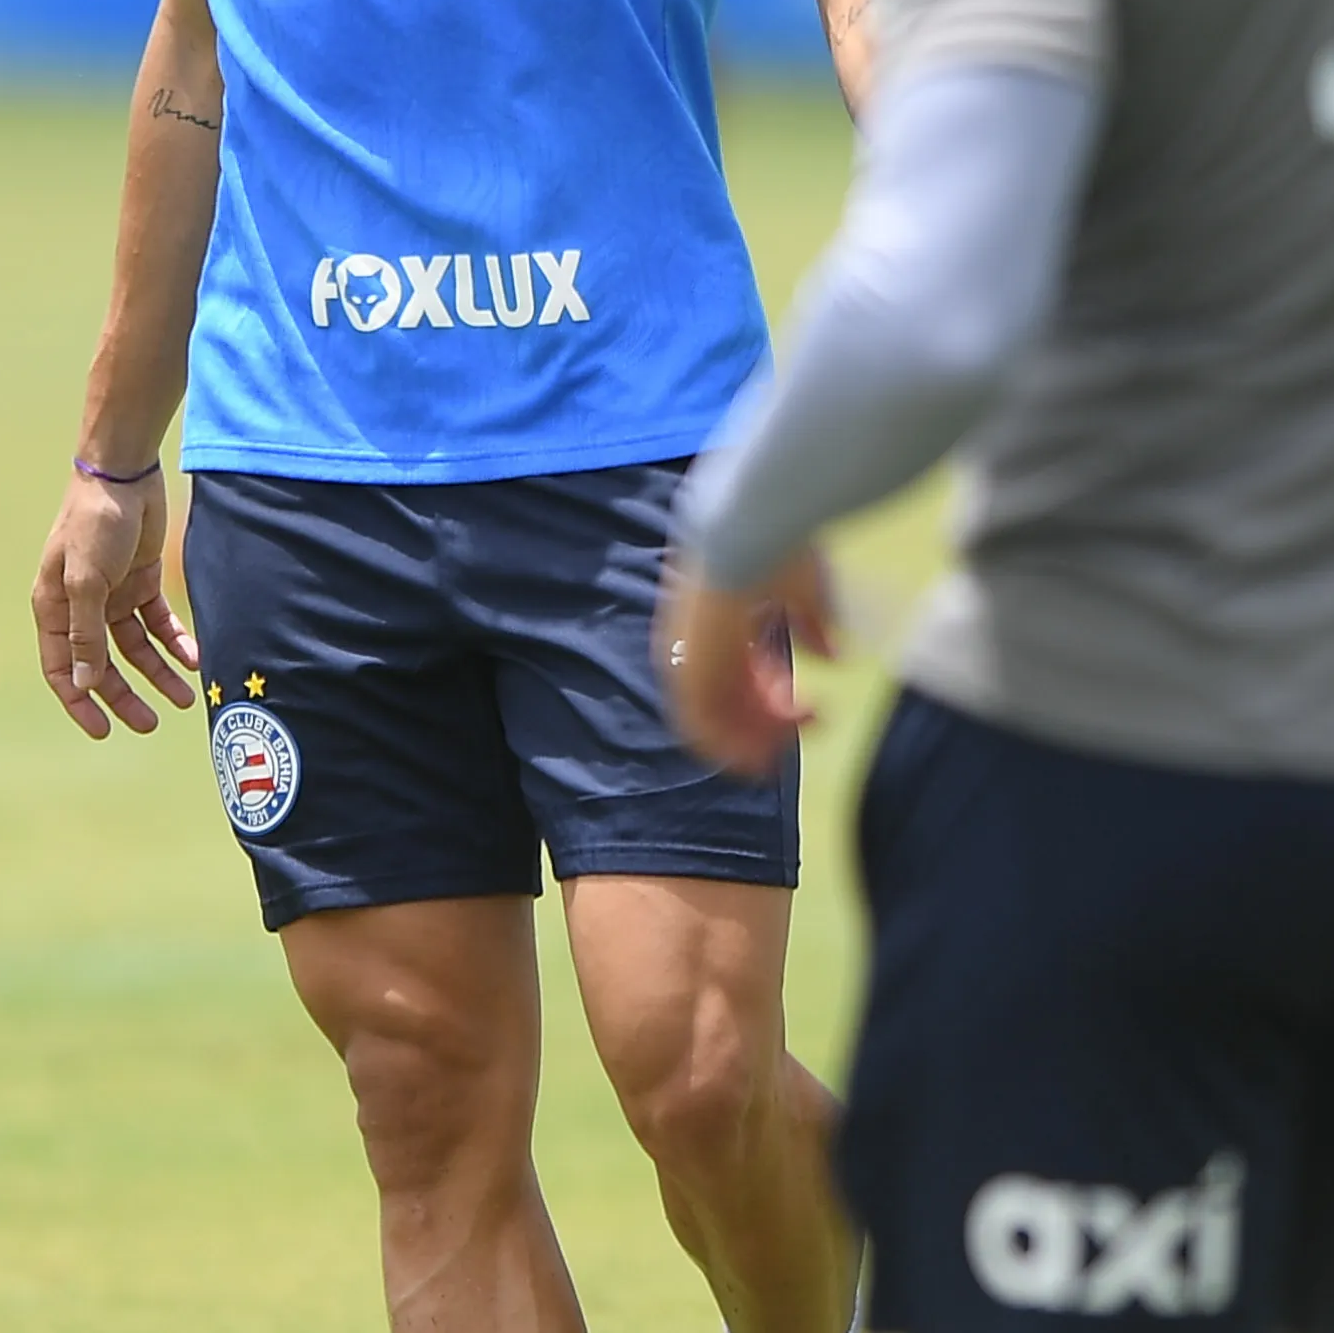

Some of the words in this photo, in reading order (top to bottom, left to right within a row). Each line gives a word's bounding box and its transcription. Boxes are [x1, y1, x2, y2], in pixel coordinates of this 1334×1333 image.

[310, 248, 592, 332] FOXLUX
[227, 713, 275, 739] CLUBE
[272, 738, 292, 794] BAHIA
[247, 809, 269, 825] 1931
